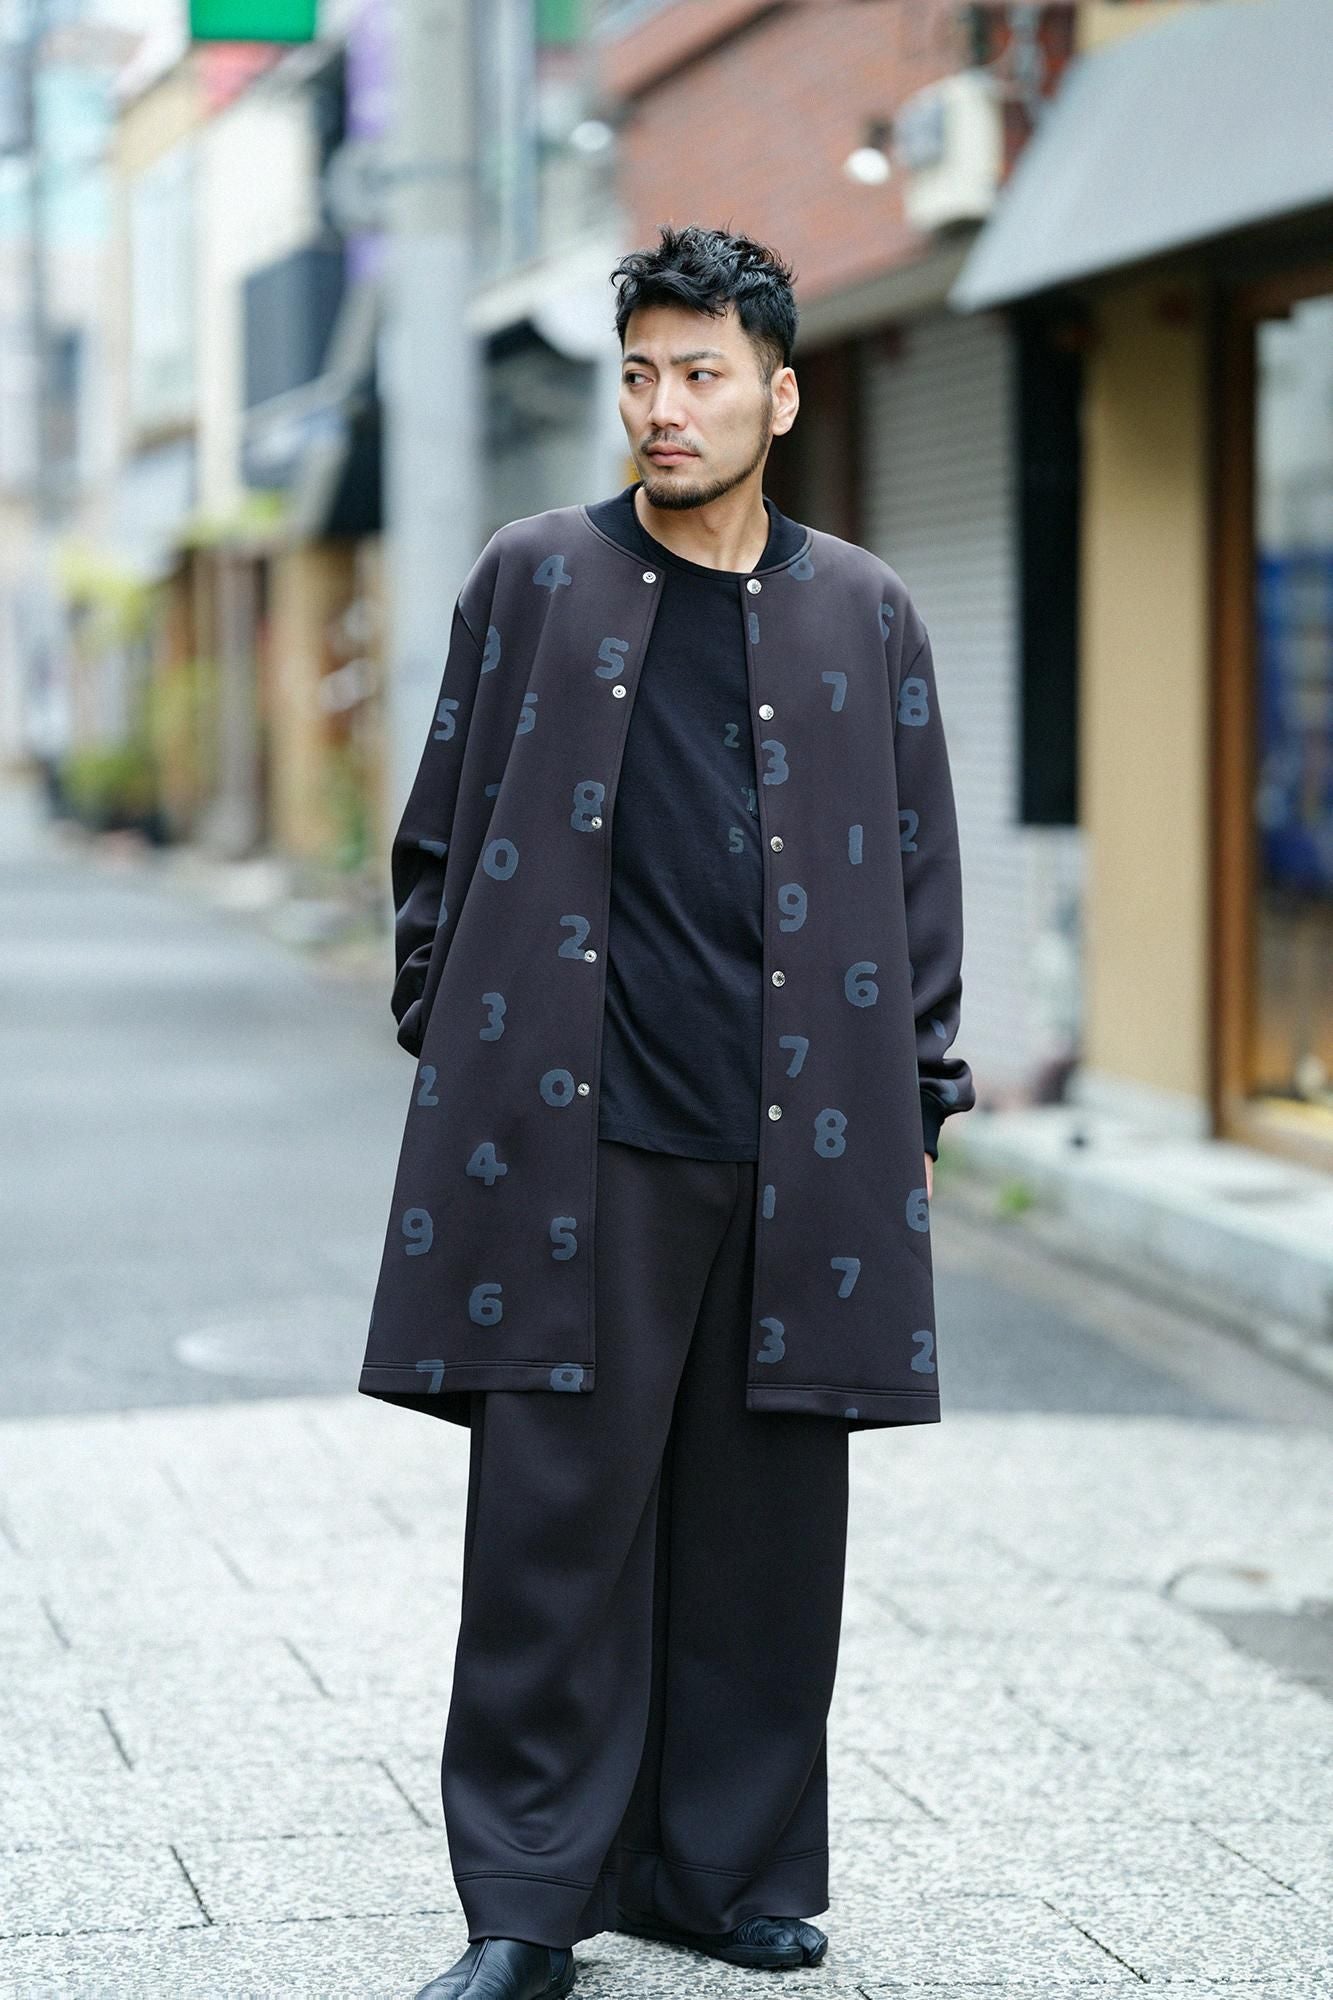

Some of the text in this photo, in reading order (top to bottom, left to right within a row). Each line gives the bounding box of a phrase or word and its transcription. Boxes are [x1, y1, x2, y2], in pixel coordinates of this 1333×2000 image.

[533, 554, 572, 592] 4
[594, 637, 630, 680] 5
[821, 671, 848, 712] 7
[898, 677, 930, 727] 8
[433, 697, 460, 741] 5
[724, 722, 740, 749] 2
[761, 739, 790, 785] 3
[570, 780, 606, 833] 8
[728, 826, 745, 853] 5
[848, 824, 863, 865] 1
[899, 809, 920, 852] 2
[483, 838, 519, 881] 0
[777, 883, 808, 933] 9
[558, 915, 592, 960] 2
[844, 961, 879, 1008] 6
[479, 992, 506, 1041] 3
[778, 1035, 810, 1078] 7
[417, 1065, 439, 1106] 2
[540, 1068, 575, 1107] 0
[814, 1108, 848, 1158] 8
[465, 1142, 508, 1186] 4
[762, 1184, 776, 1219] 1
[906, 1188, 930, 1233] 6
[402, 1208, 434, 1256] 9
[550, 1216, 578, 1261] 5
[830, 1256, 861, 1299] 7
[469, 1283, 504, 1326] 6
[756, 1317, 786, 1364] 3
[910, 1330, 936, 1374] 2
[416, 1359, 445, 1394] 7
